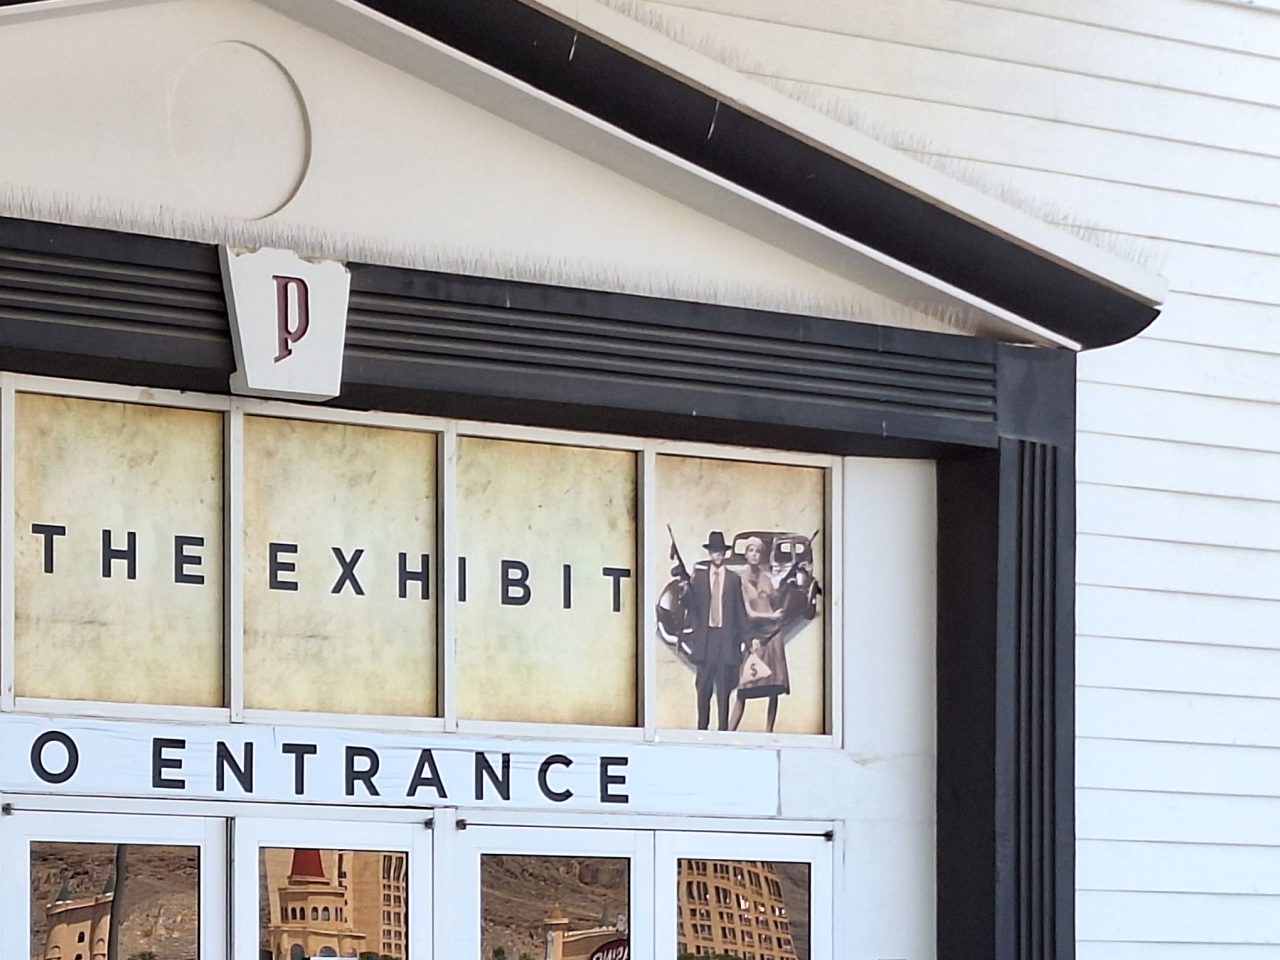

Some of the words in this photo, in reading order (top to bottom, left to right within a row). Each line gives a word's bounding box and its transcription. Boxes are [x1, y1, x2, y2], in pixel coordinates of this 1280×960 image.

[272, 275, 310, 364] P
[31, 523, 206, 585] THE
[267, 542, 632, 614] EXHIBIT
[152, 737, 630, 804] ENTRANCE
